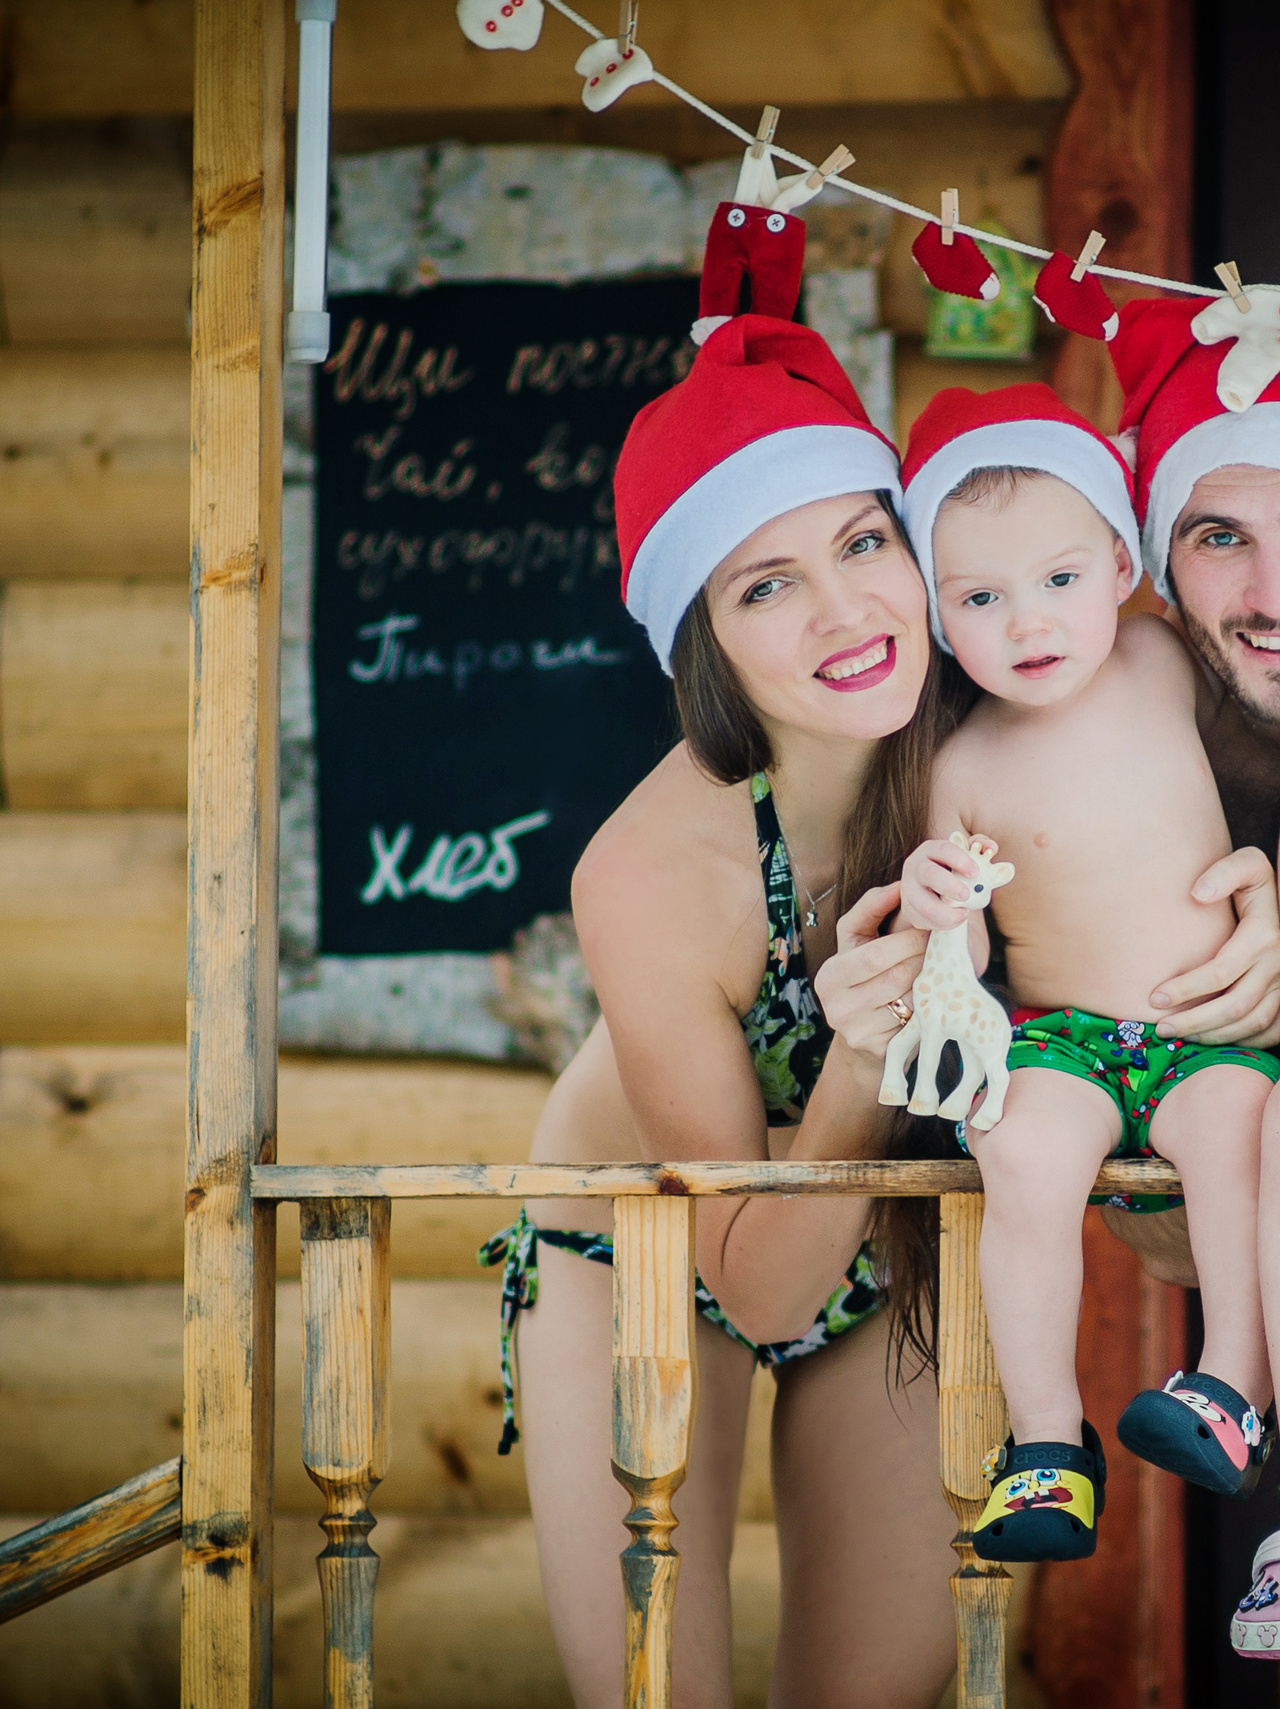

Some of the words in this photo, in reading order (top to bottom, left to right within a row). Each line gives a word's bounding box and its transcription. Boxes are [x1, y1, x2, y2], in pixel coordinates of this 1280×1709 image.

[323, 317, 476, 421] Щи
[361, 809, 551, 905] Хлеб
[1014, 1448, 1072, 1464] crocs
